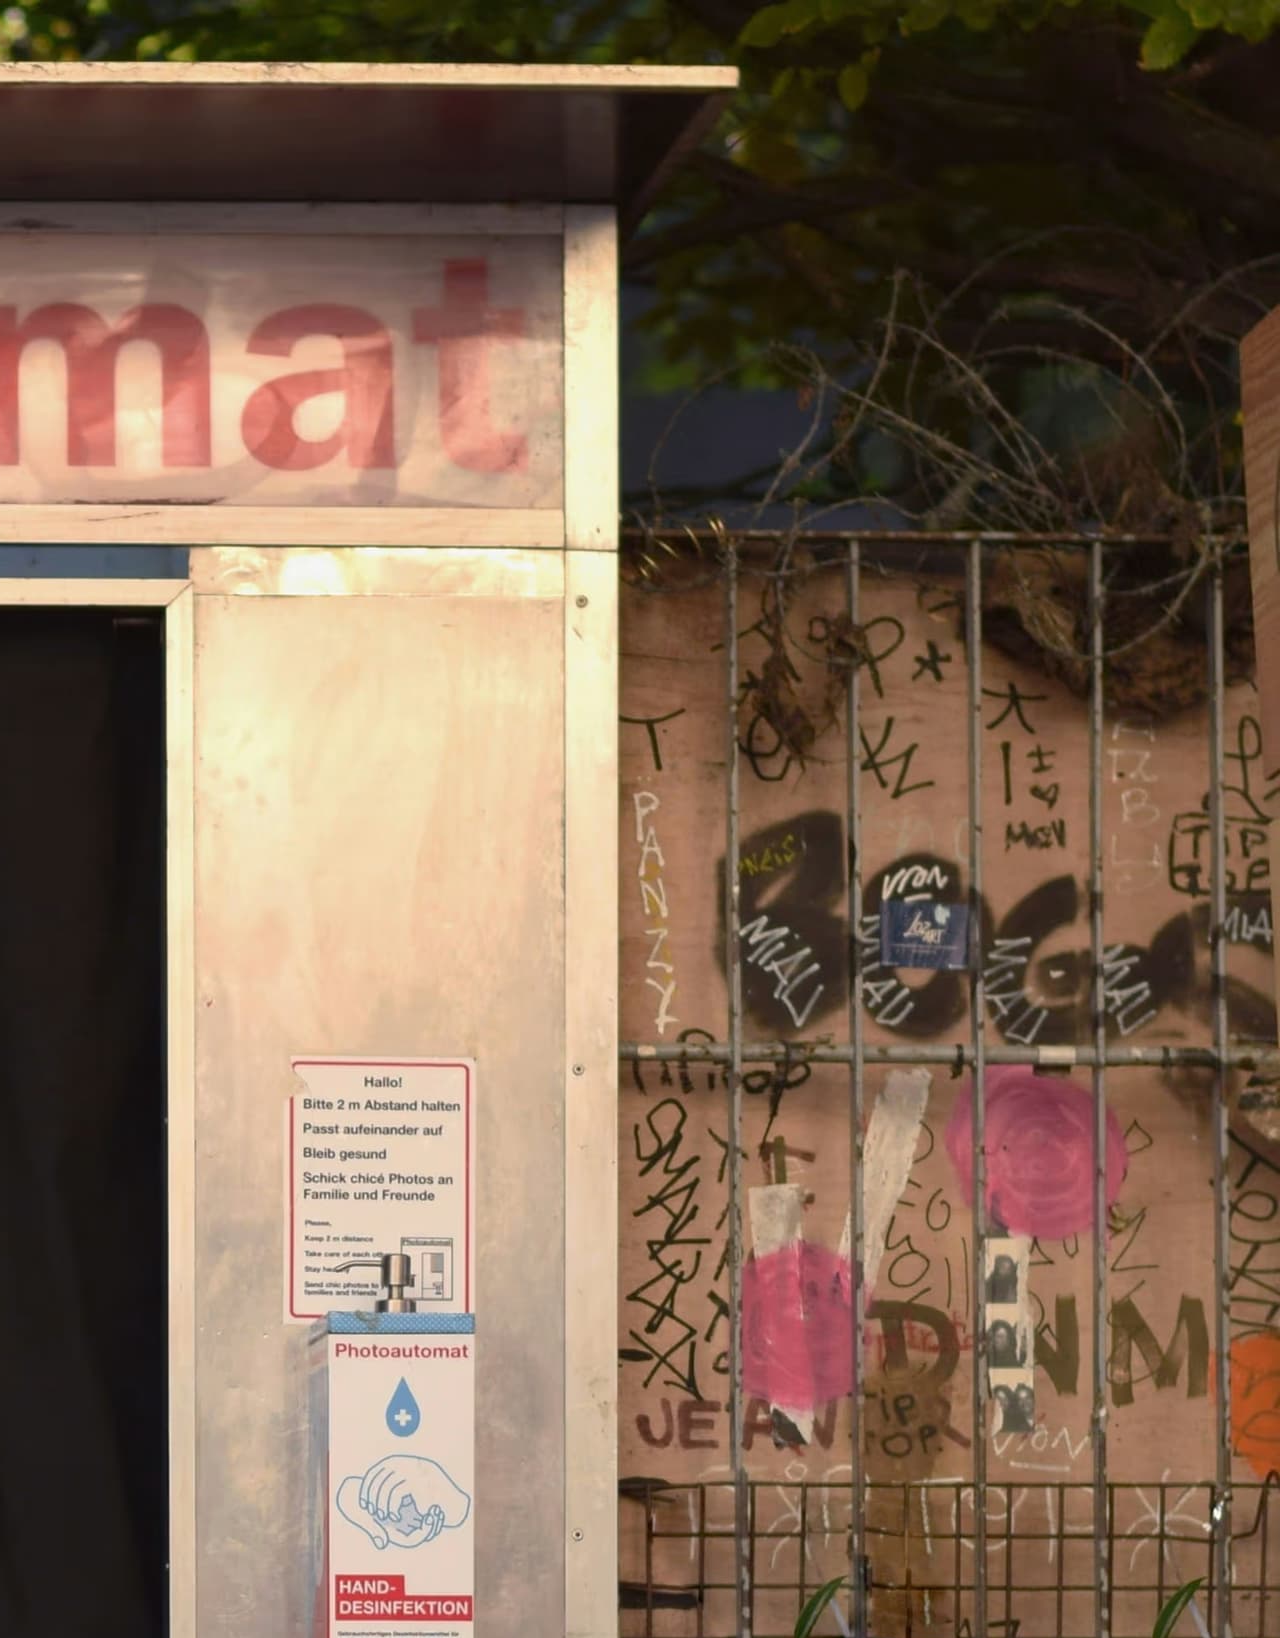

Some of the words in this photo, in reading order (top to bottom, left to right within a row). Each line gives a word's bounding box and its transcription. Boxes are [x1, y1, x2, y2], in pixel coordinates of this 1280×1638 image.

[364, 1076, 403, 1089] Hallo!
[303, 1098, 333, 1110] Bitte
[337, 1099, 345, 1110] 2
[348, 1102, 360, 1110] m
[364, 1099, 417, 1111] Abstand
[421, 1100, 461, 1112] halten
[303, 1123, 339, 1135] Passt
[343, 1123, 418, 1136] aufeinander
[422, 1125, 443, 1136] auf
[303, 1147, 335, 1159] Bleib
[339, 1148, 387, 1161] gesund
[303, 1172, 346, 1184] Schick
[389, 1173, 434, 1185] Photos
[437, 1174, 453, 1185] an
[303, 1188, 350, 1200] Familie
[353, 1189, 378, 1201] und
[382, 1189, 435, 1201] Freunde
[335, 1342, 468, 1359] Photoautomat
[339, 1580, 397, 1595] HAND-
[339, 1599, 469, 1616] DESINFEKTION
